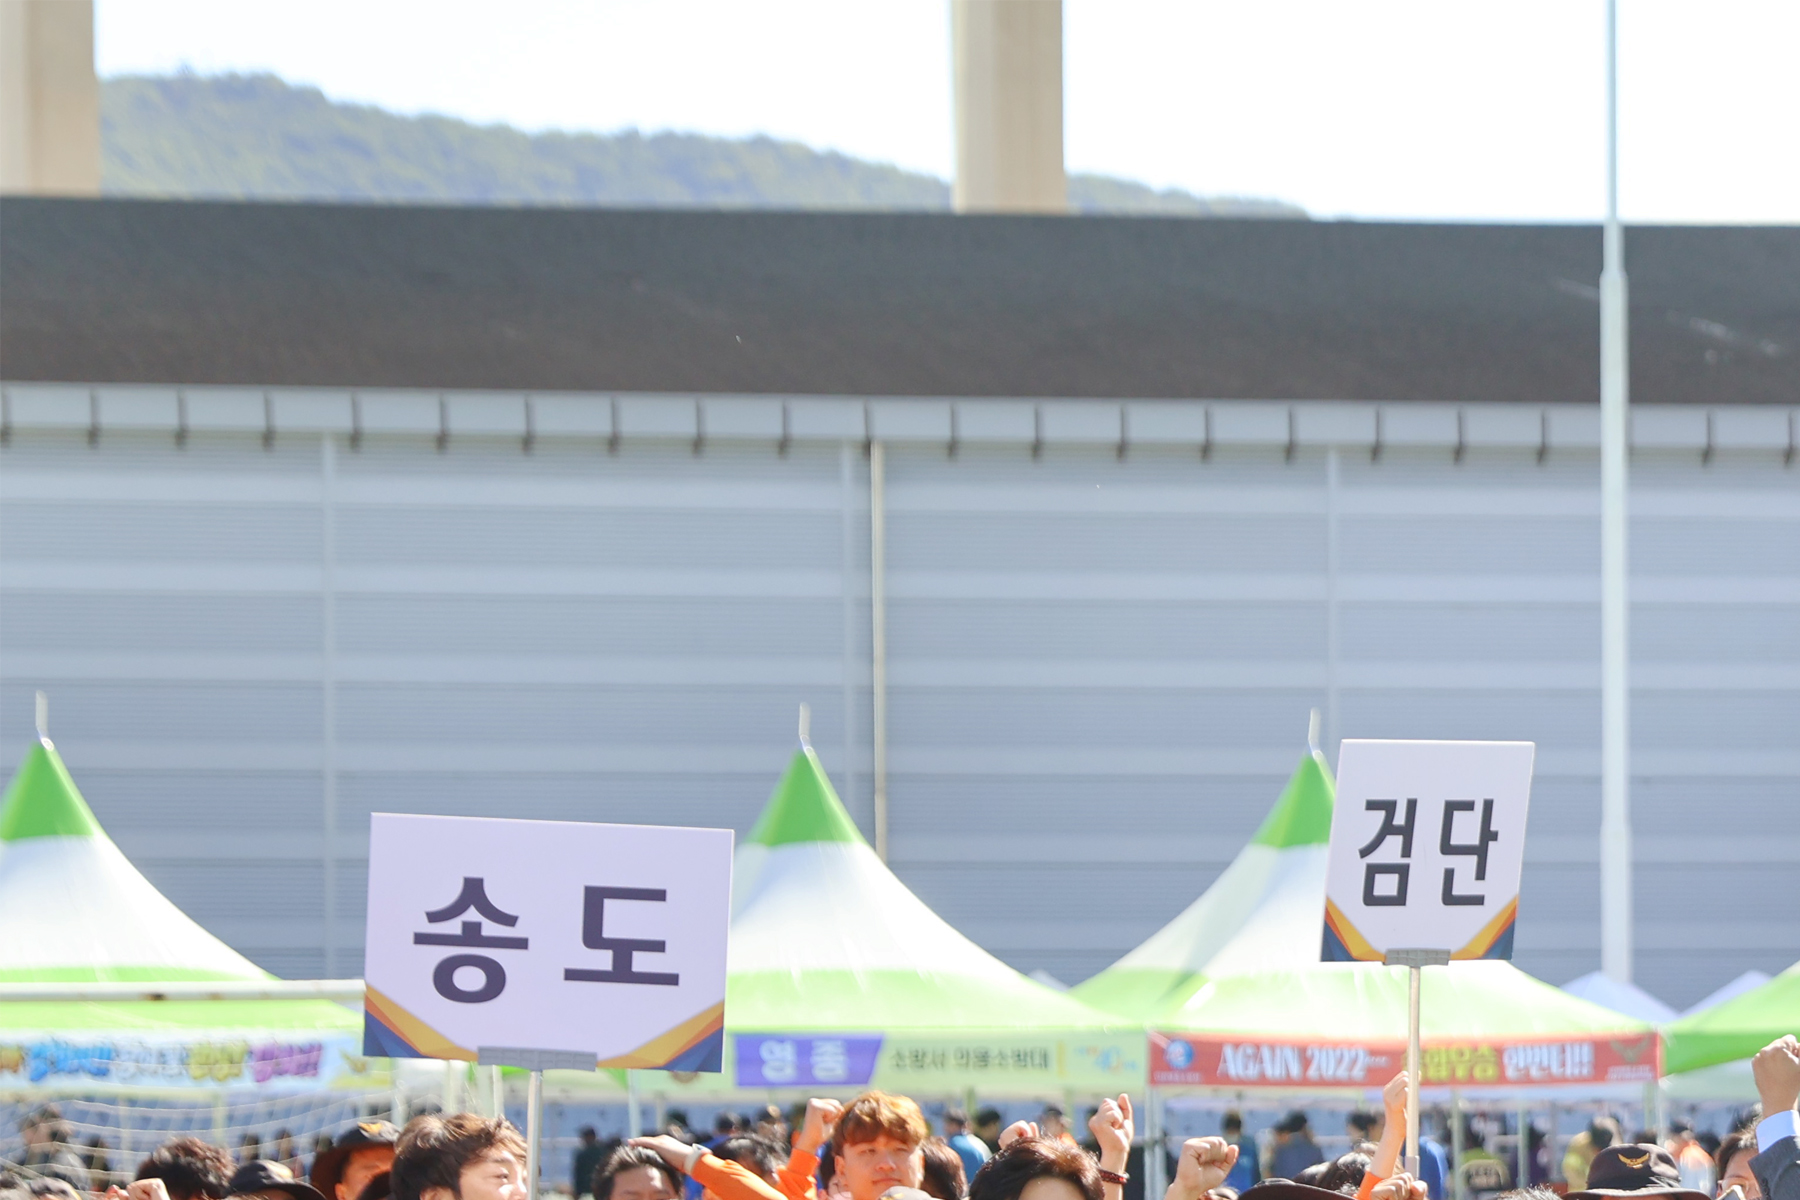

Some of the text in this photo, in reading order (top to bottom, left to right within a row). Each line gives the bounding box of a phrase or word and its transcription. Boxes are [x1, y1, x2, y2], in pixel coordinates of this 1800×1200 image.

[1358, 798, 1499, 907] 검단
[413, 876, 680, 1004] 송도
[1217, 1043, 1302, 1081] AGAIN
